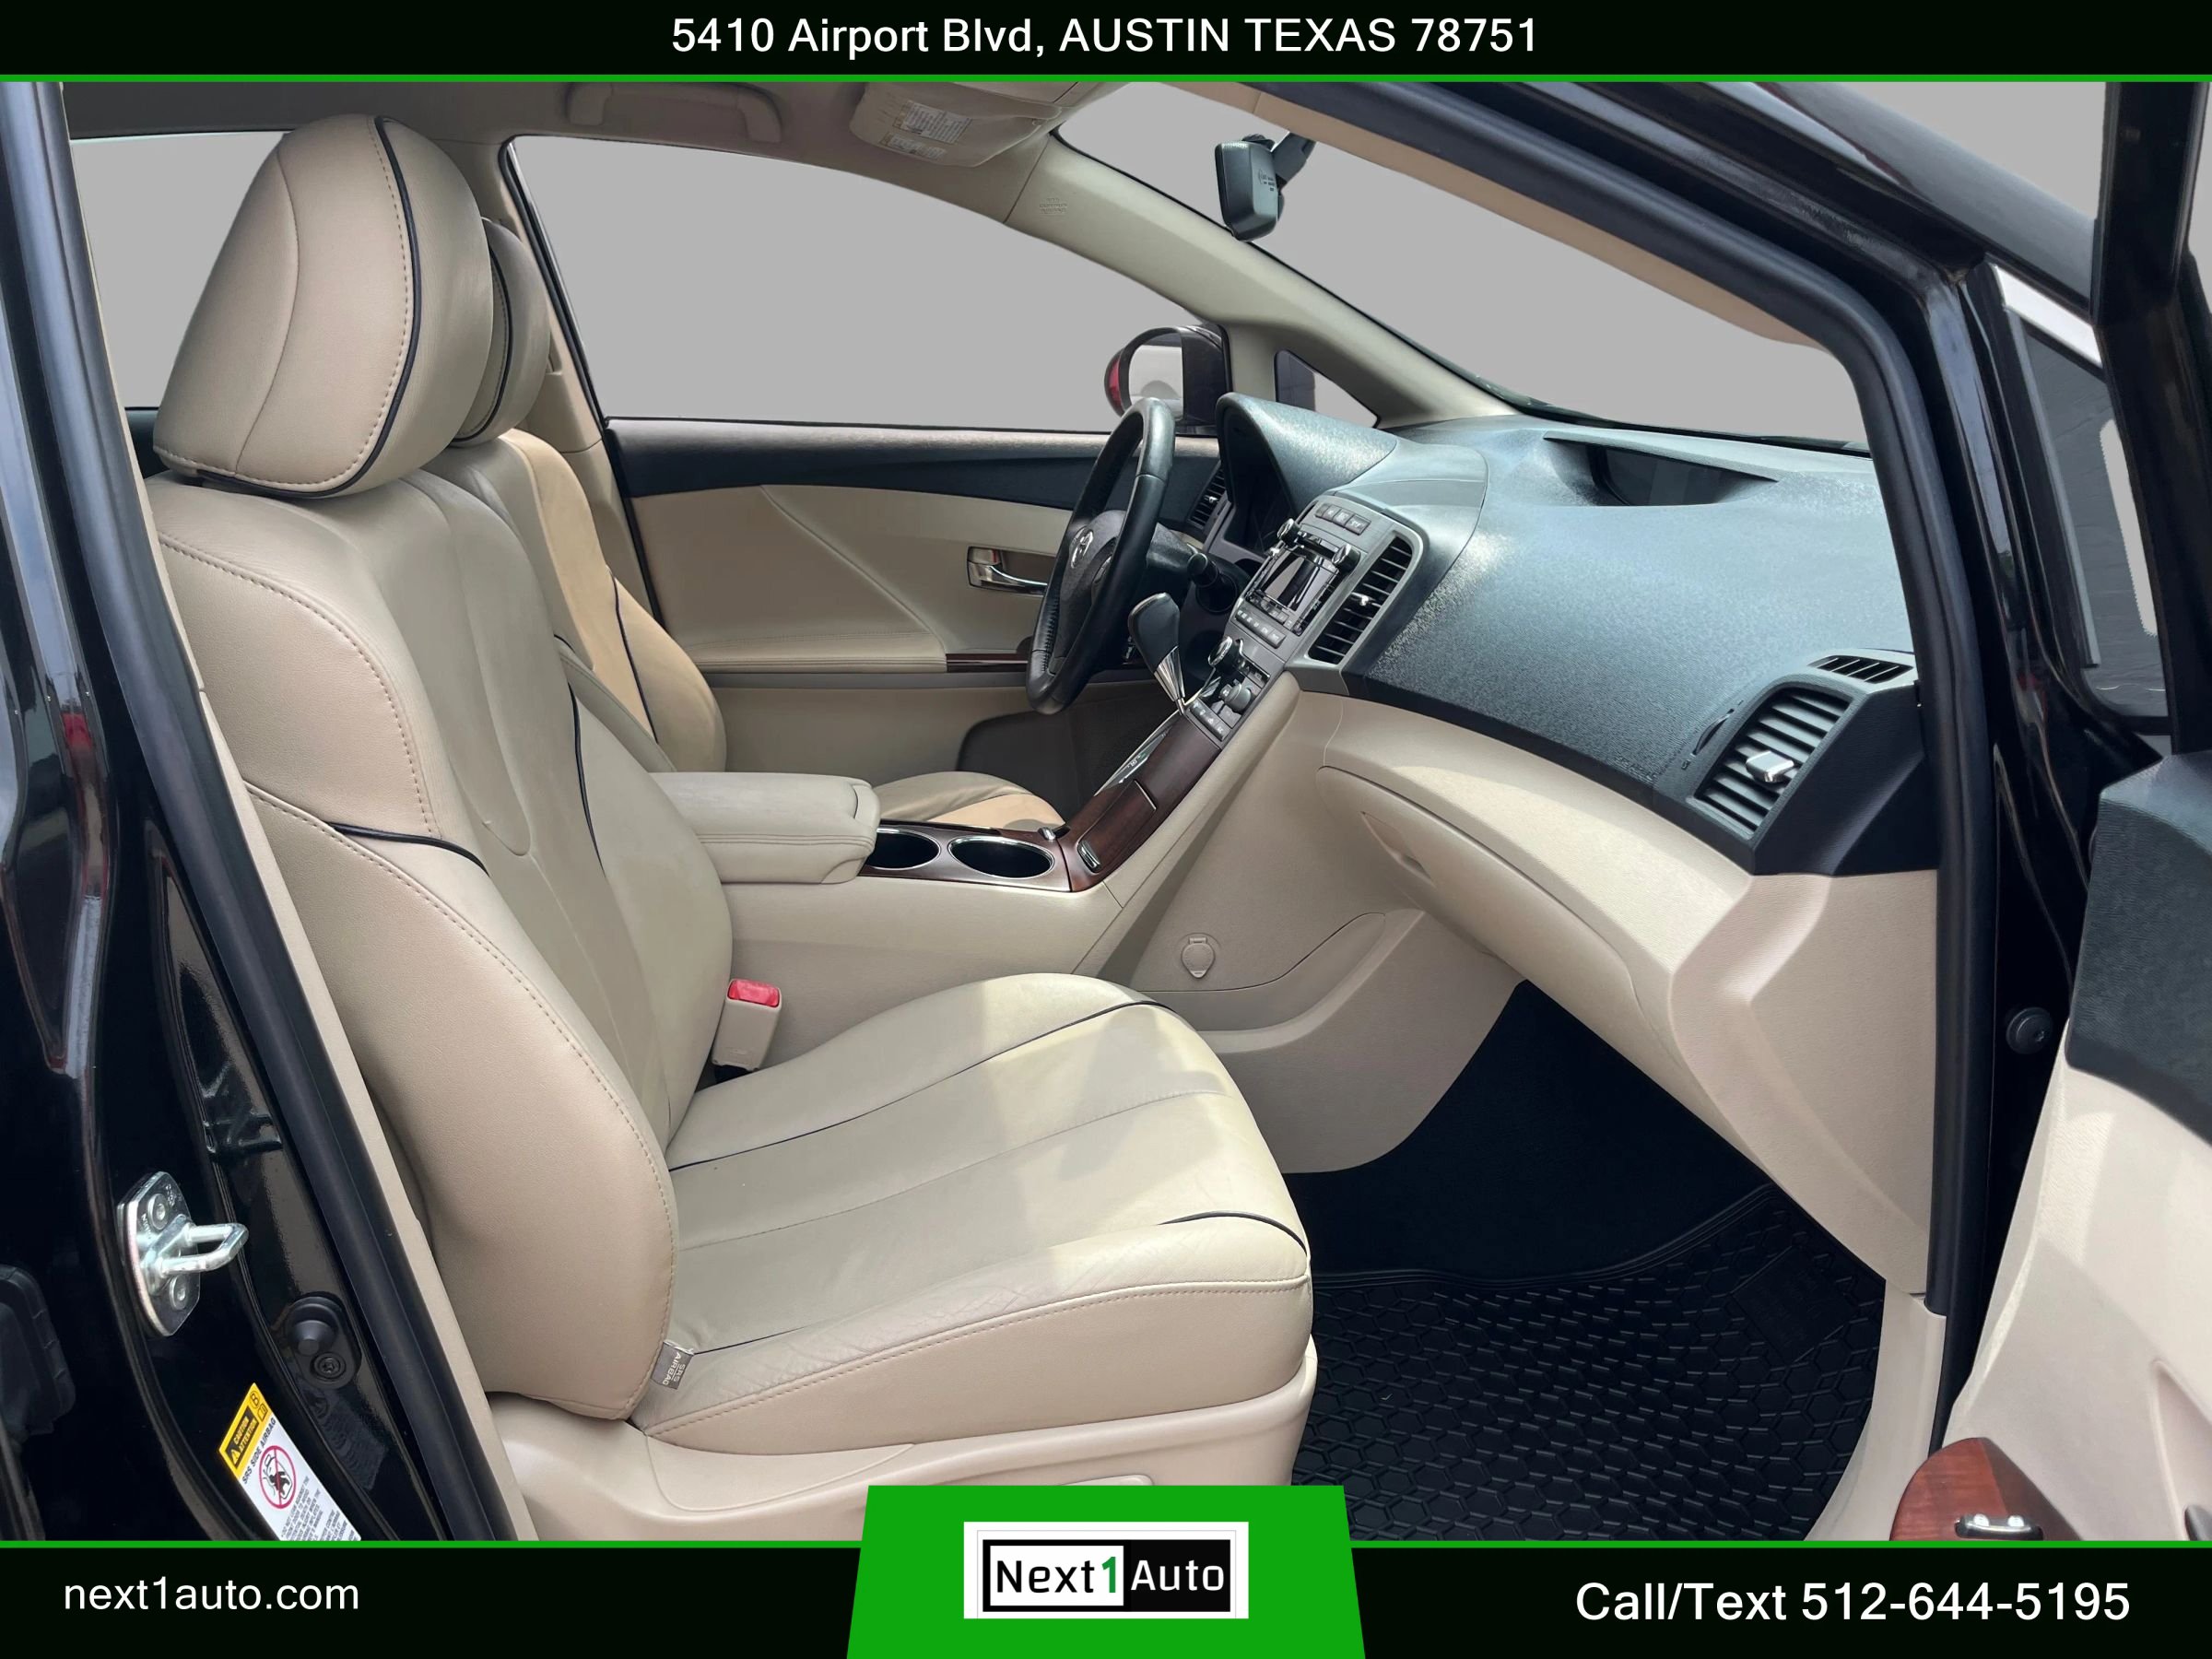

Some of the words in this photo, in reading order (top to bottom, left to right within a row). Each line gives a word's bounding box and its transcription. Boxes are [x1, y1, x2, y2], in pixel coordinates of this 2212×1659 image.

[663, 1351, 682, 1385] AIRBAG
[241, 1465, 252, 1484] SRS
[250, 1445, 261, 1467] SIDE
[259, 1417, 276, 1448] AIRBAG
